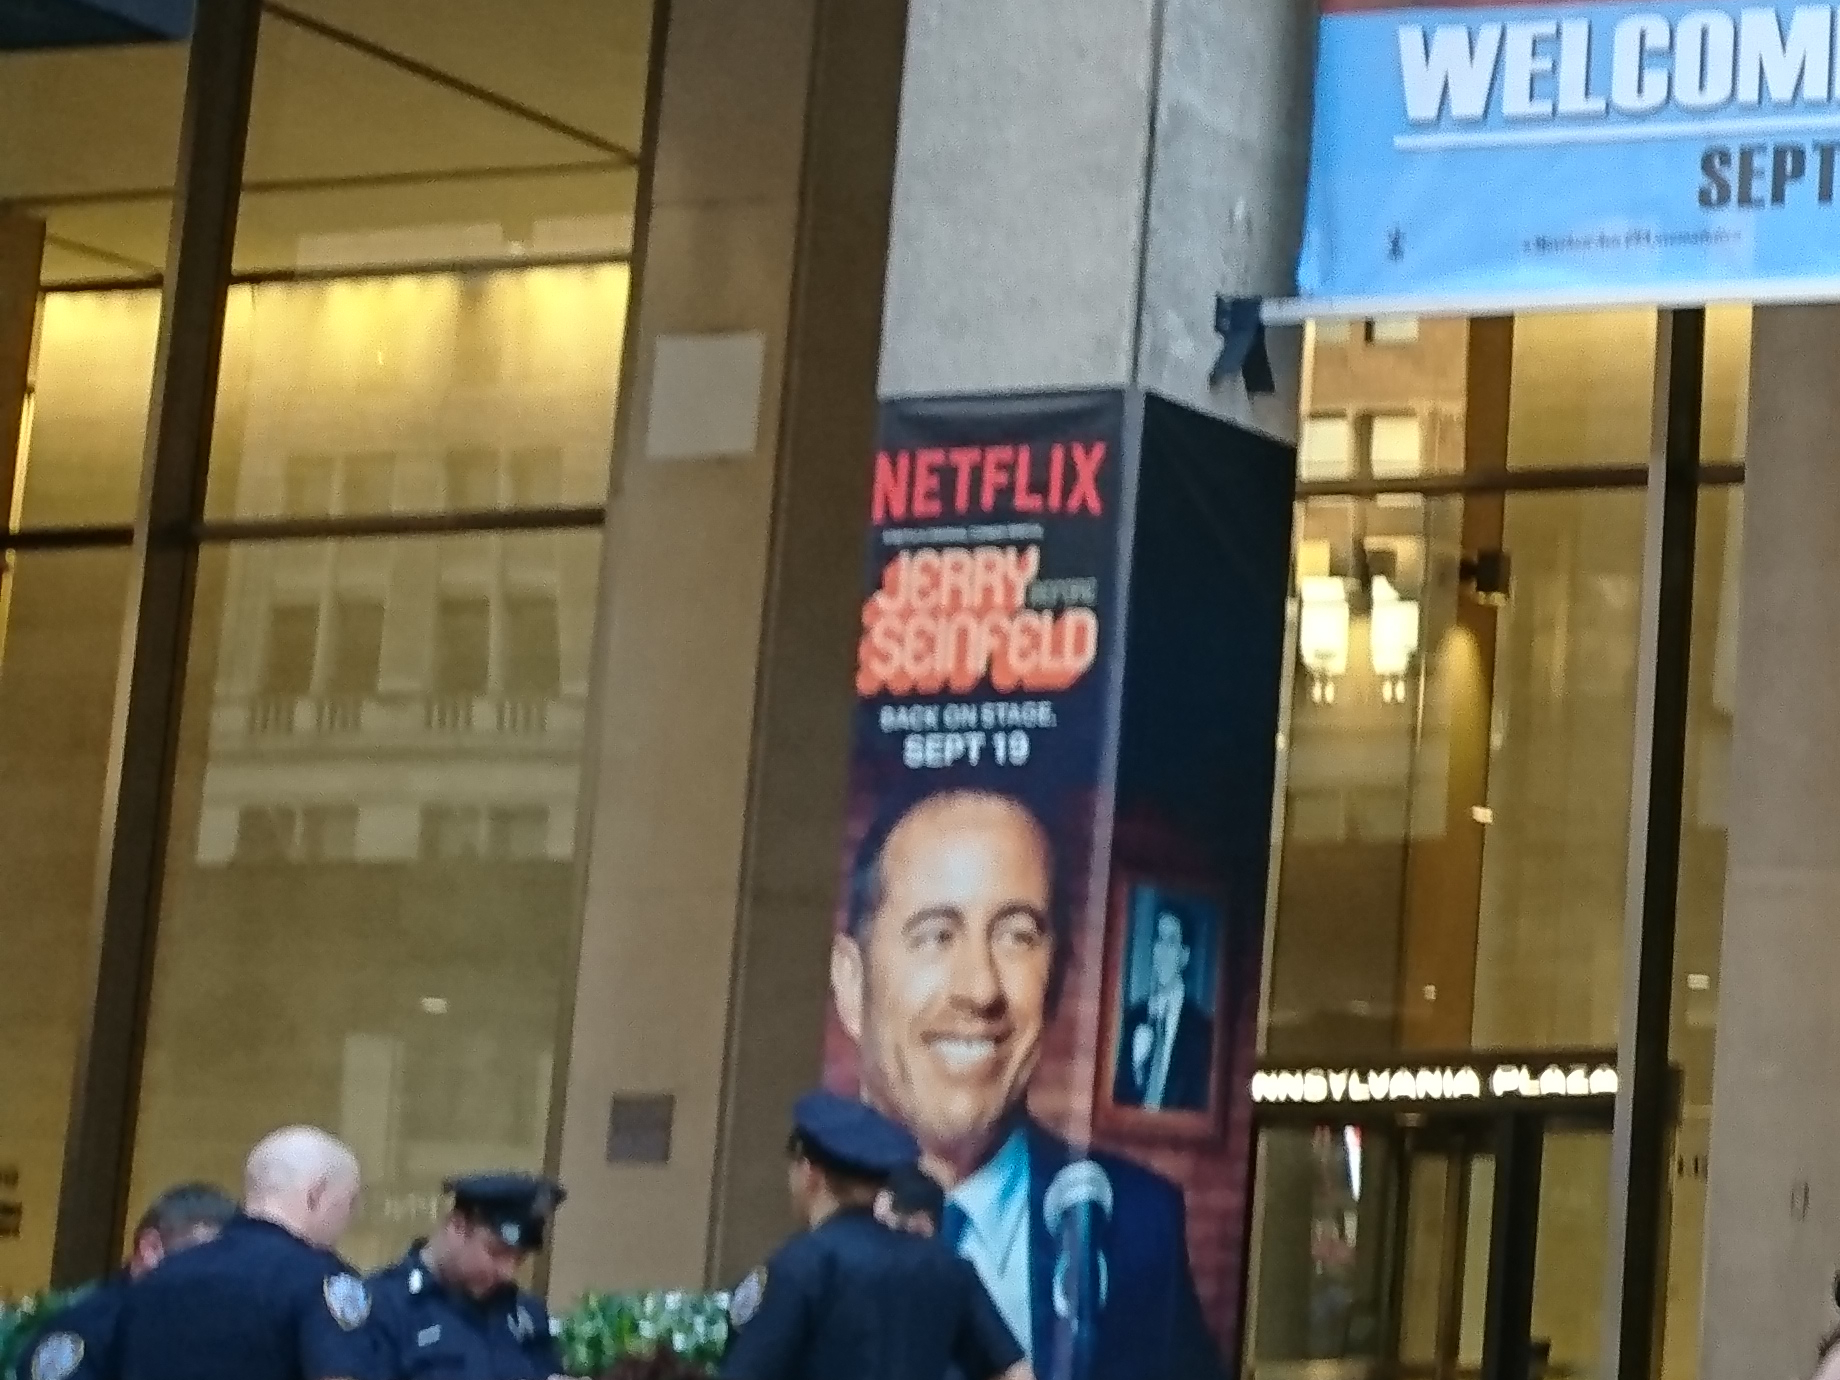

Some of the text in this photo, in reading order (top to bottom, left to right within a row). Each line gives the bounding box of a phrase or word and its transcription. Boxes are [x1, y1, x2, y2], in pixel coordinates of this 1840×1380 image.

[871, 442, 1108, 526] NETFLIX
[864, 545, 1041, 612] JERRY
[857, 606, 1100, 696] SEINFELD
[903, 731, 987, 769] SEPT
[1493, 1064, 1618, 1097] PLAZA
